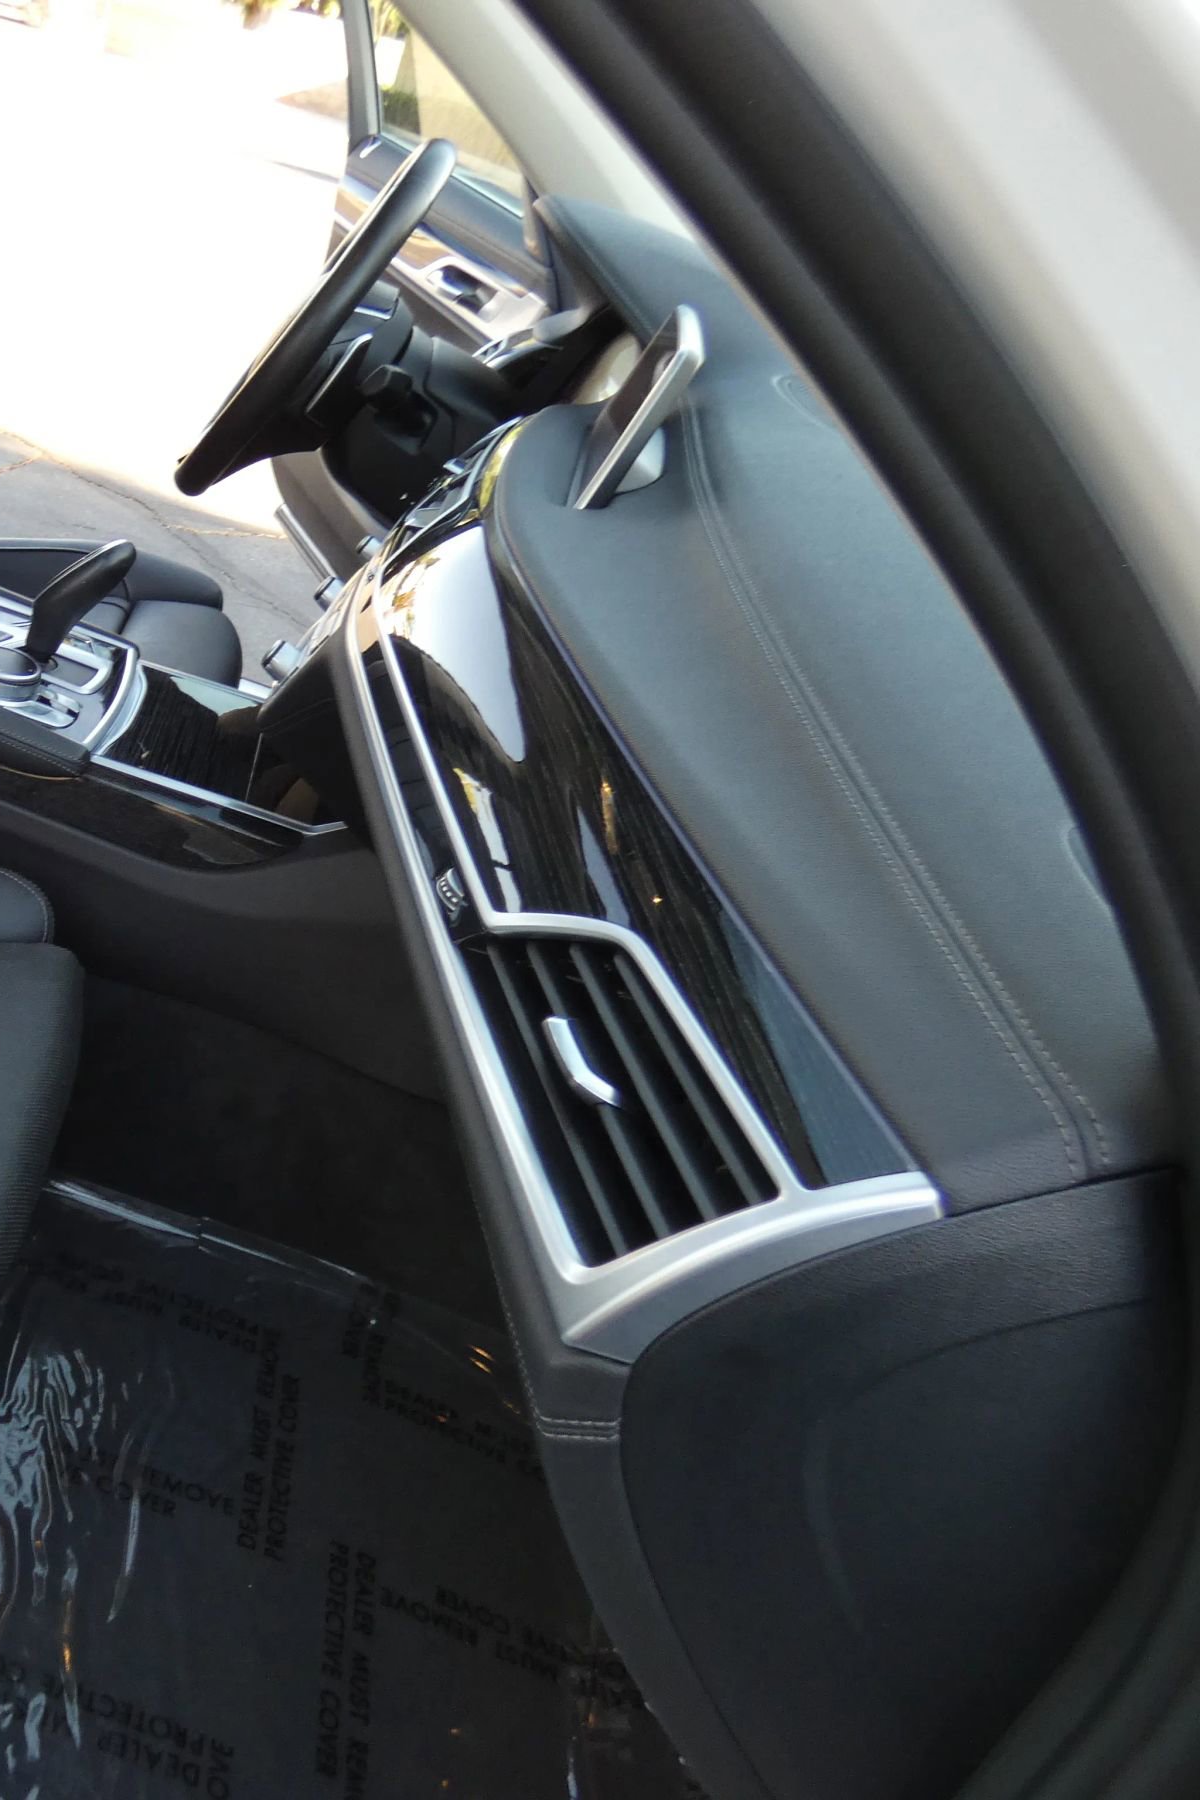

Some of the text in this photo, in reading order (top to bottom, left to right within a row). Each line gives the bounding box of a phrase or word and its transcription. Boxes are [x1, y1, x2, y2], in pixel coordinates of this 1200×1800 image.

[236, 1327, 282, 1551] DEALER MUST REMOVE
[263, 1373, 301, 1563] PROTECTIVE COVER
[314, 1537, 350, 1779] PROTECTIVE COVER
[352, 1549, 377, 1637] DEALER
[97, 1730, 201, 1788] DEALER
[348, 1652, 372, 1728] MUST
